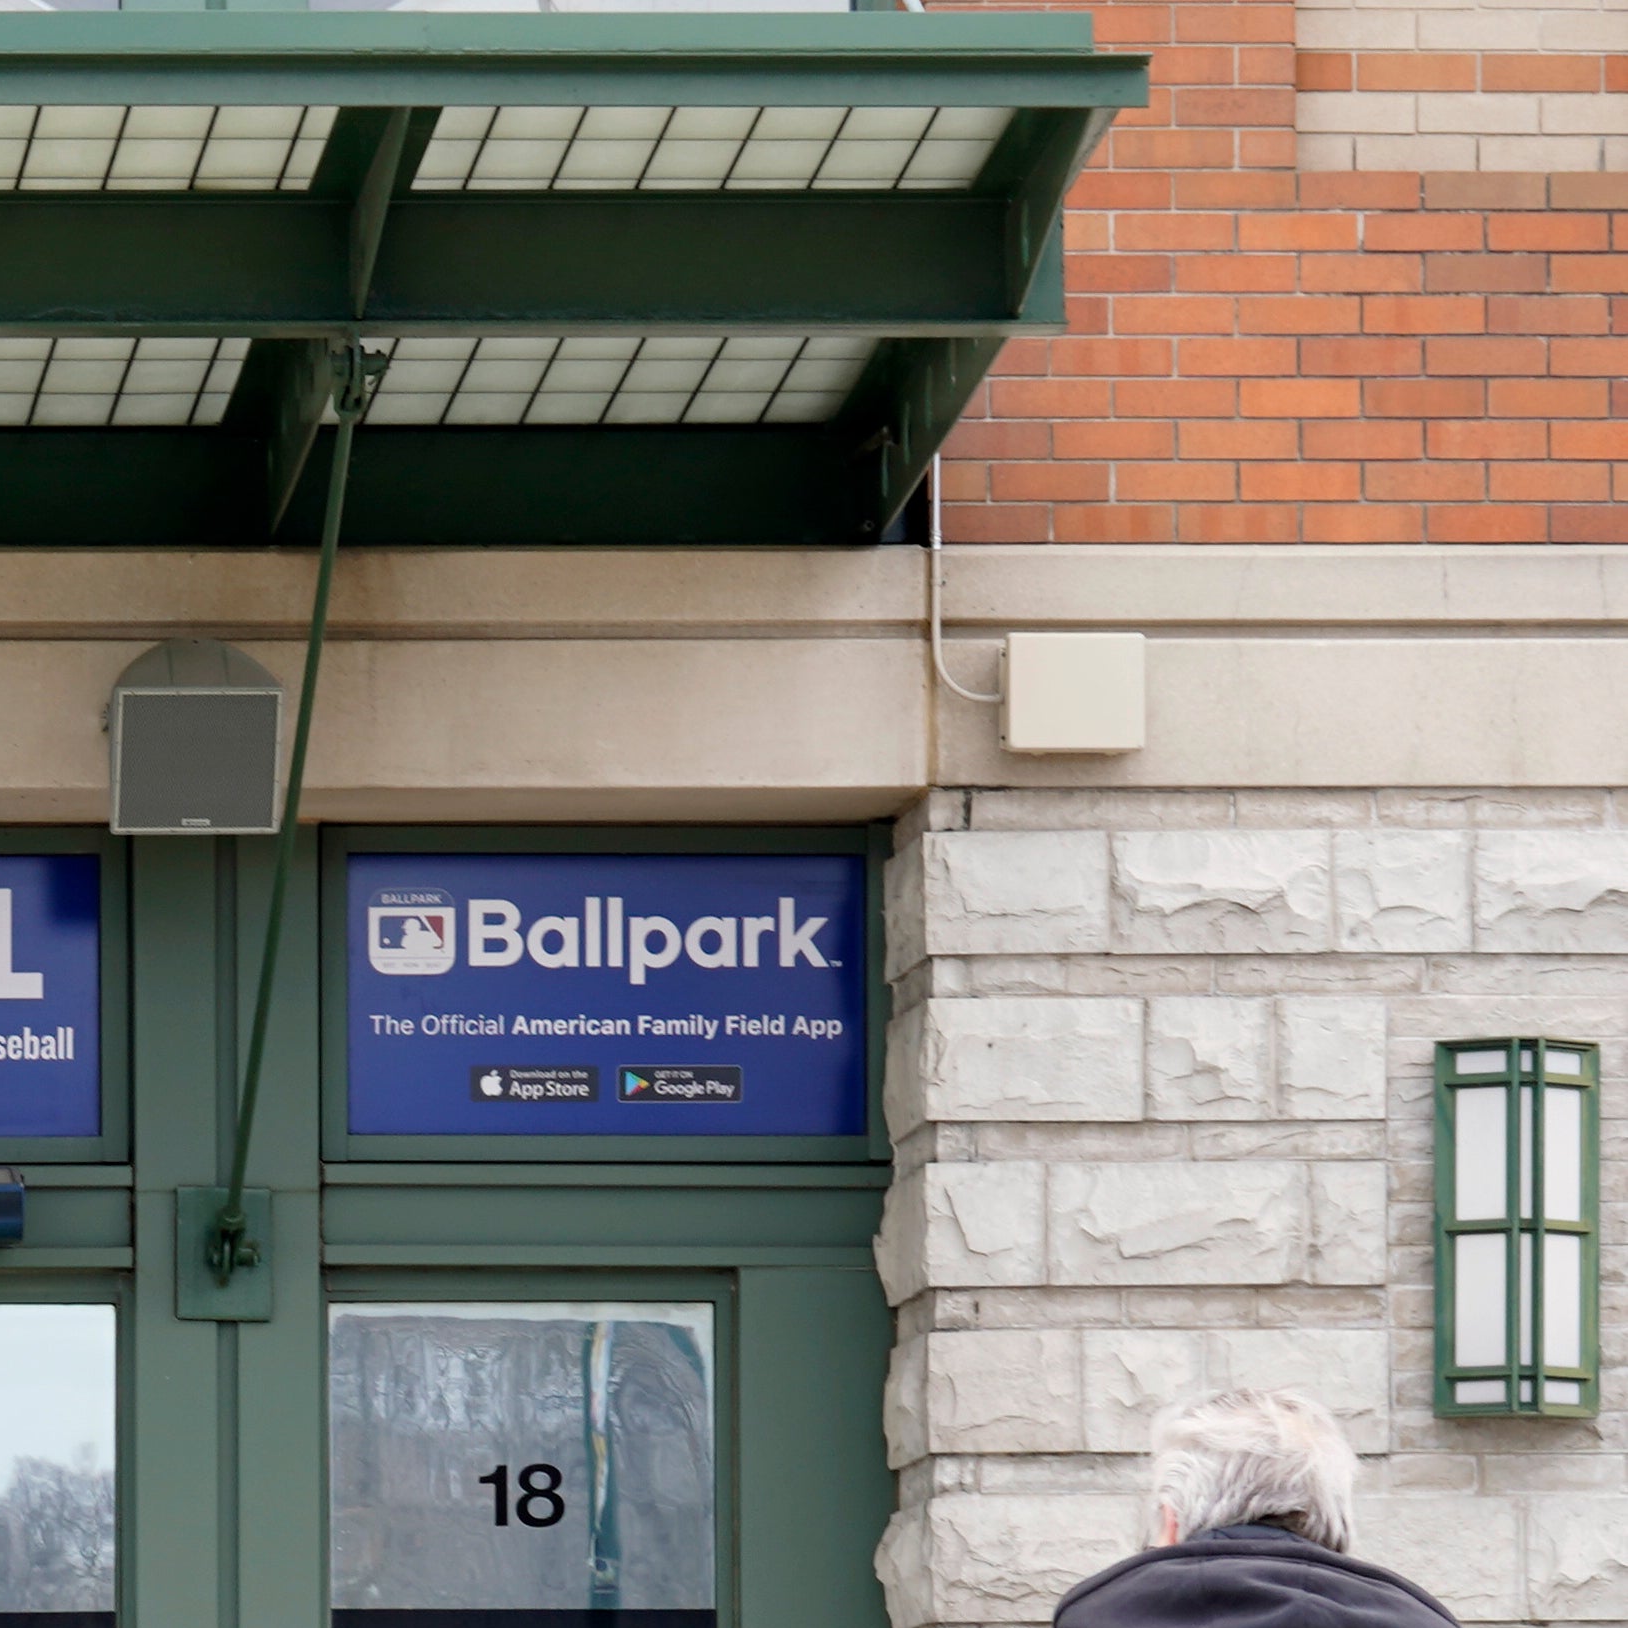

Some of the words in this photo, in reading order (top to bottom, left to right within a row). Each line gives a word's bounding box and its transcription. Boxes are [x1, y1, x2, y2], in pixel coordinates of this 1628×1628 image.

[380, 893, 443, 905] BALLPARK
[369, 1015, 414, 1036] The
[420, 1015, 505, 1036] Official
[512, 1014, 630, 1037] American
[637, 1014, 719, 1040] Family
[724, 1014, 786, 1036] Field
[791, 1015, 843, 1039] App
[509, 1080, 545, 1100] App
[546, 1080, 590, 1098] Store
[654, 1080, 704, 1098] Google
[706, 1080, 735, 1098] Play
[478, 1463, 565, 1528] 18
